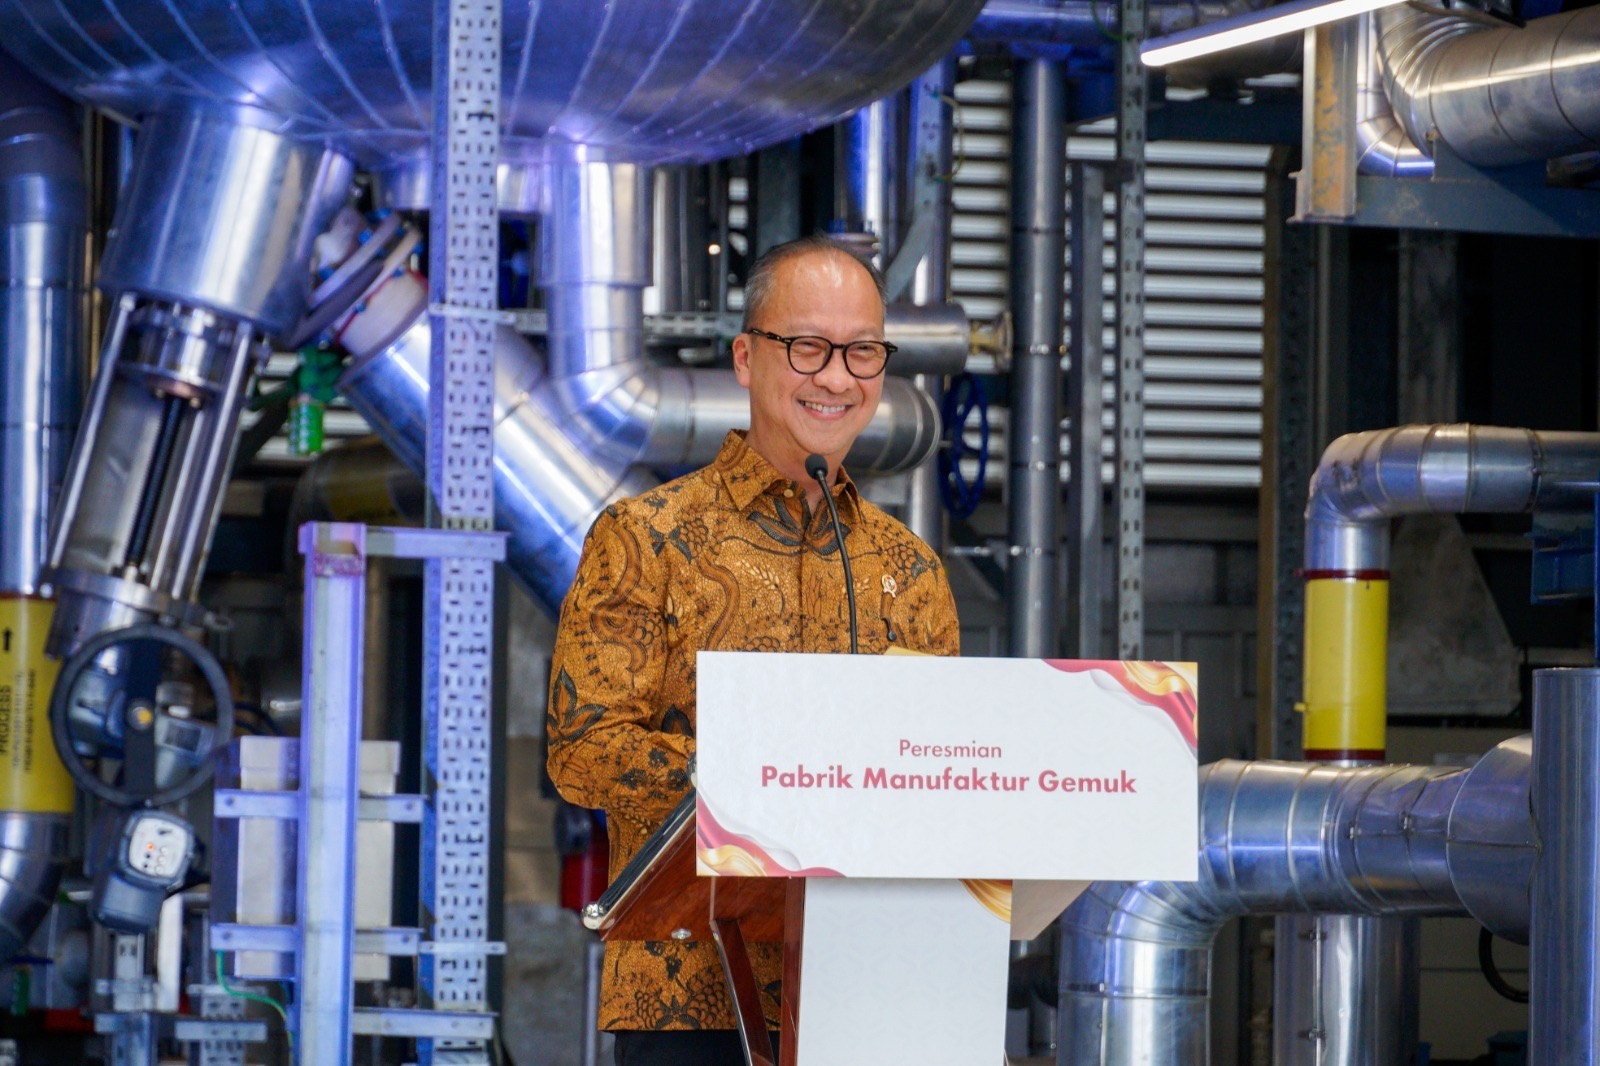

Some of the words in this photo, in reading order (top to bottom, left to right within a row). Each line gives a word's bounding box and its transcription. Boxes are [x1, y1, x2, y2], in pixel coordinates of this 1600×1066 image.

[899, 739, 1002, 758] Peresmian
[762, 764, 853, 788] Pabrik
[863, 767, 1029, 791] Manufaktur
[1038, 770, 1137, 794] Gemuk
